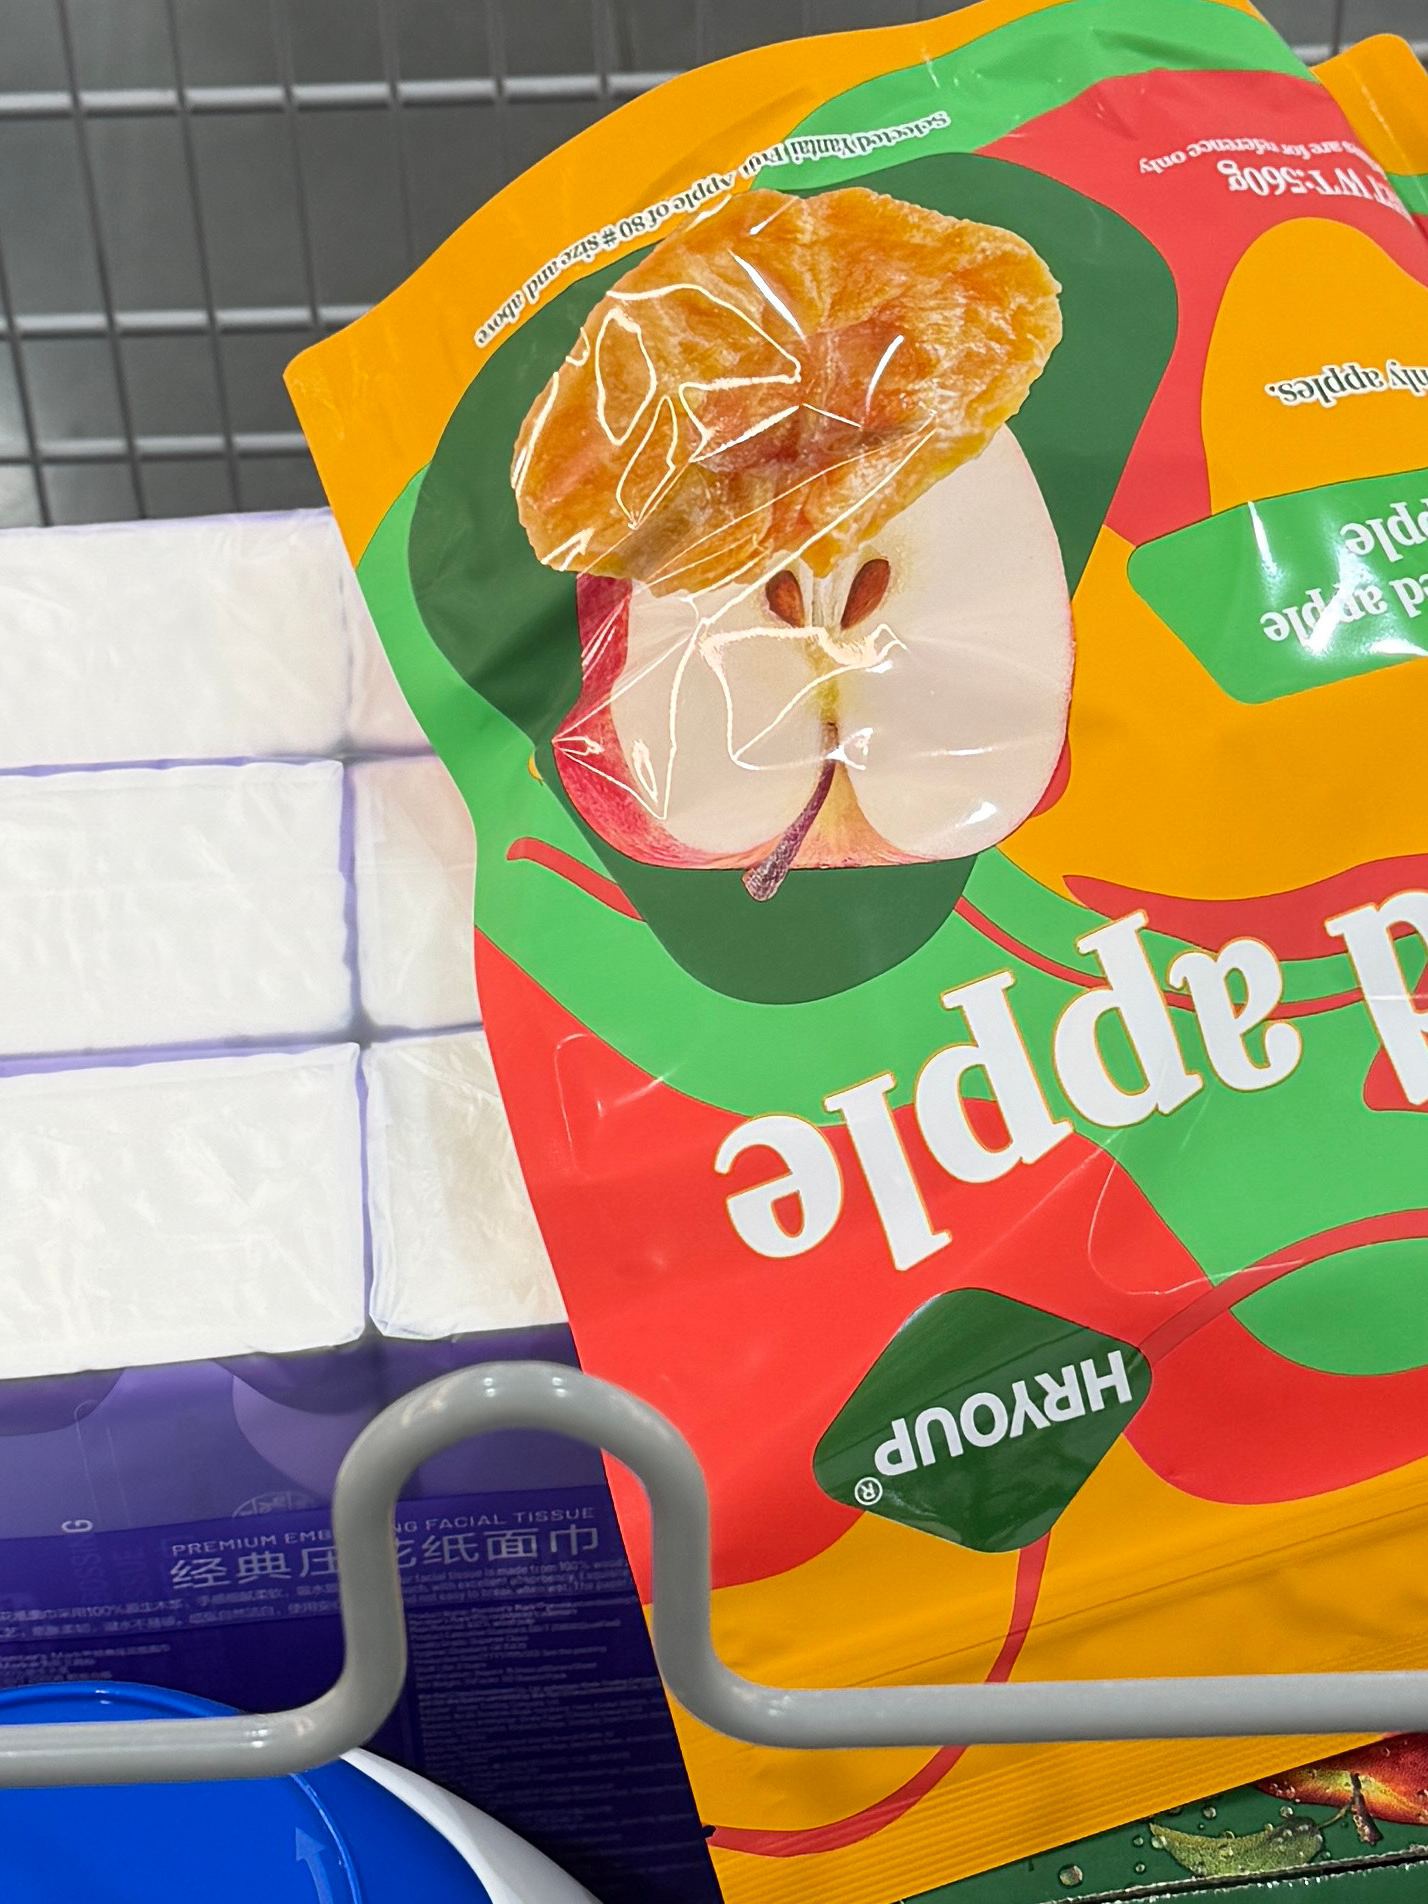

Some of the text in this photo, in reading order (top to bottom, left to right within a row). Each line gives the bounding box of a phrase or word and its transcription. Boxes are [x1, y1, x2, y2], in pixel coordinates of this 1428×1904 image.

[791, 138, 858, 163] Yantai
[1140, 150, 1186, 174] only
[619, 215, 646, 238] 80
[645, 202, 672, 230] of
[561, 235, 600, 267] size
[527, 260, 561, 300] and
[477, 293, 526, 346] above
[1267, 367, 1383, 406] apples.
[715, 909, 1302, 1271] apple
[172, 1534, 277, 1557] PREMIUM
[426, 1512, 507, 1531] FACIAL
[513, 1506, 596, 1524] TISSUE
